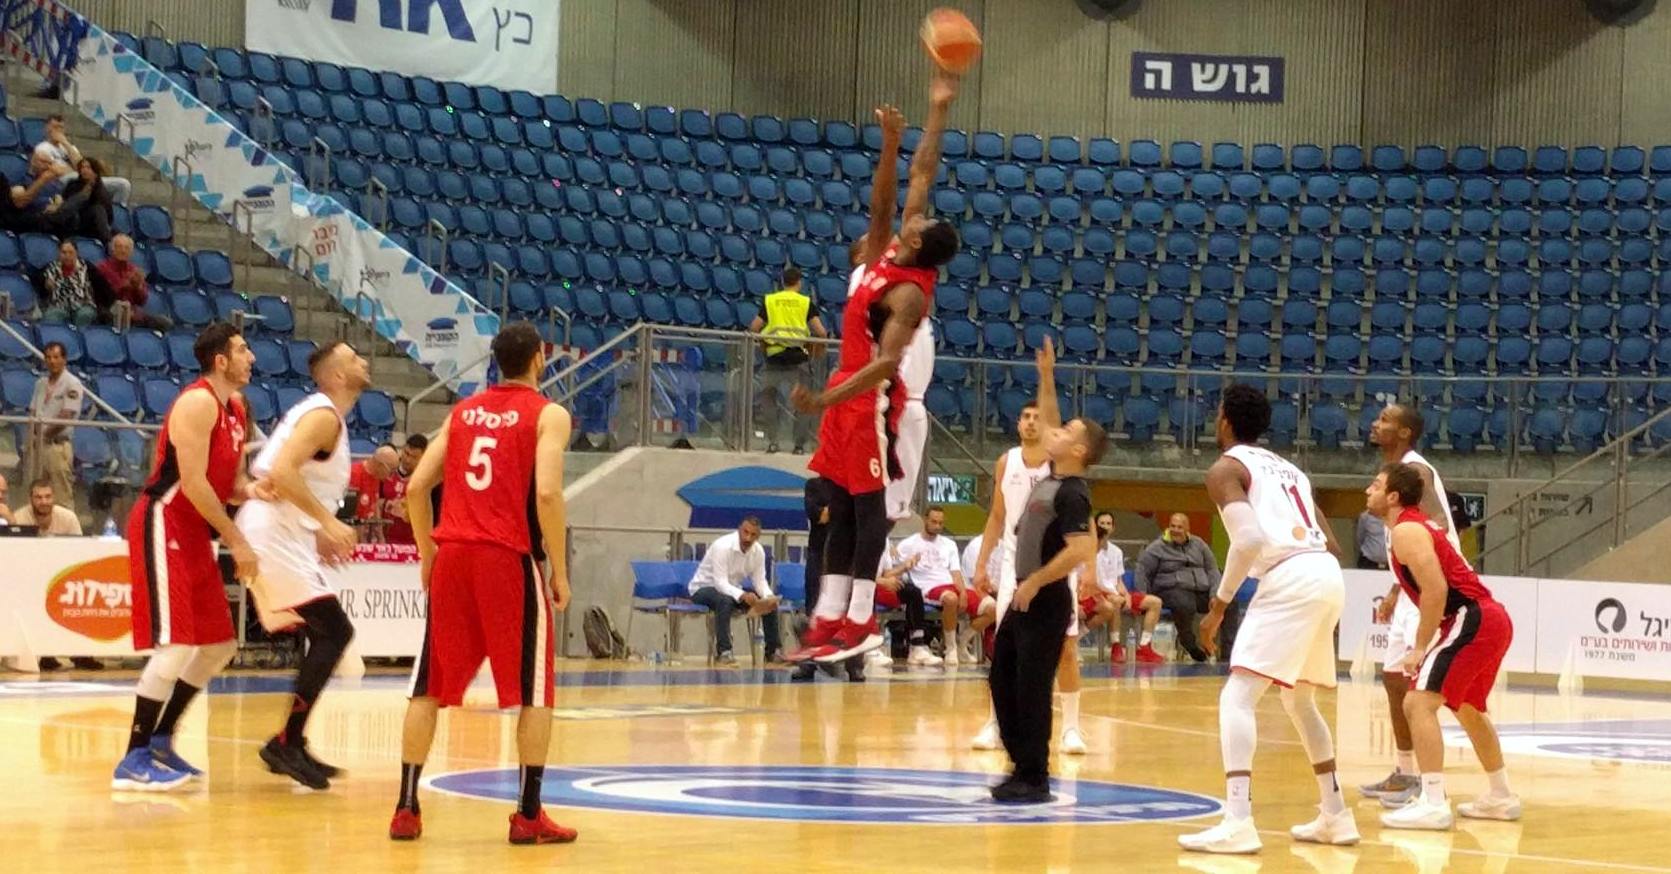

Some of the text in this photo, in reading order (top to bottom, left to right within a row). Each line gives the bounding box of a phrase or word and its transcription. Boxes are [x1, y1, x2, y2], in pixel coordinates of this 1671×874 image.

[493, 7, 533, 51] כץ
[1144, 60, 1270, 94] גוש ה
[465, 436, 497, 491] 5
[869, 458, 881, 478] 6
[1370, 633, 1389, 648] 195
